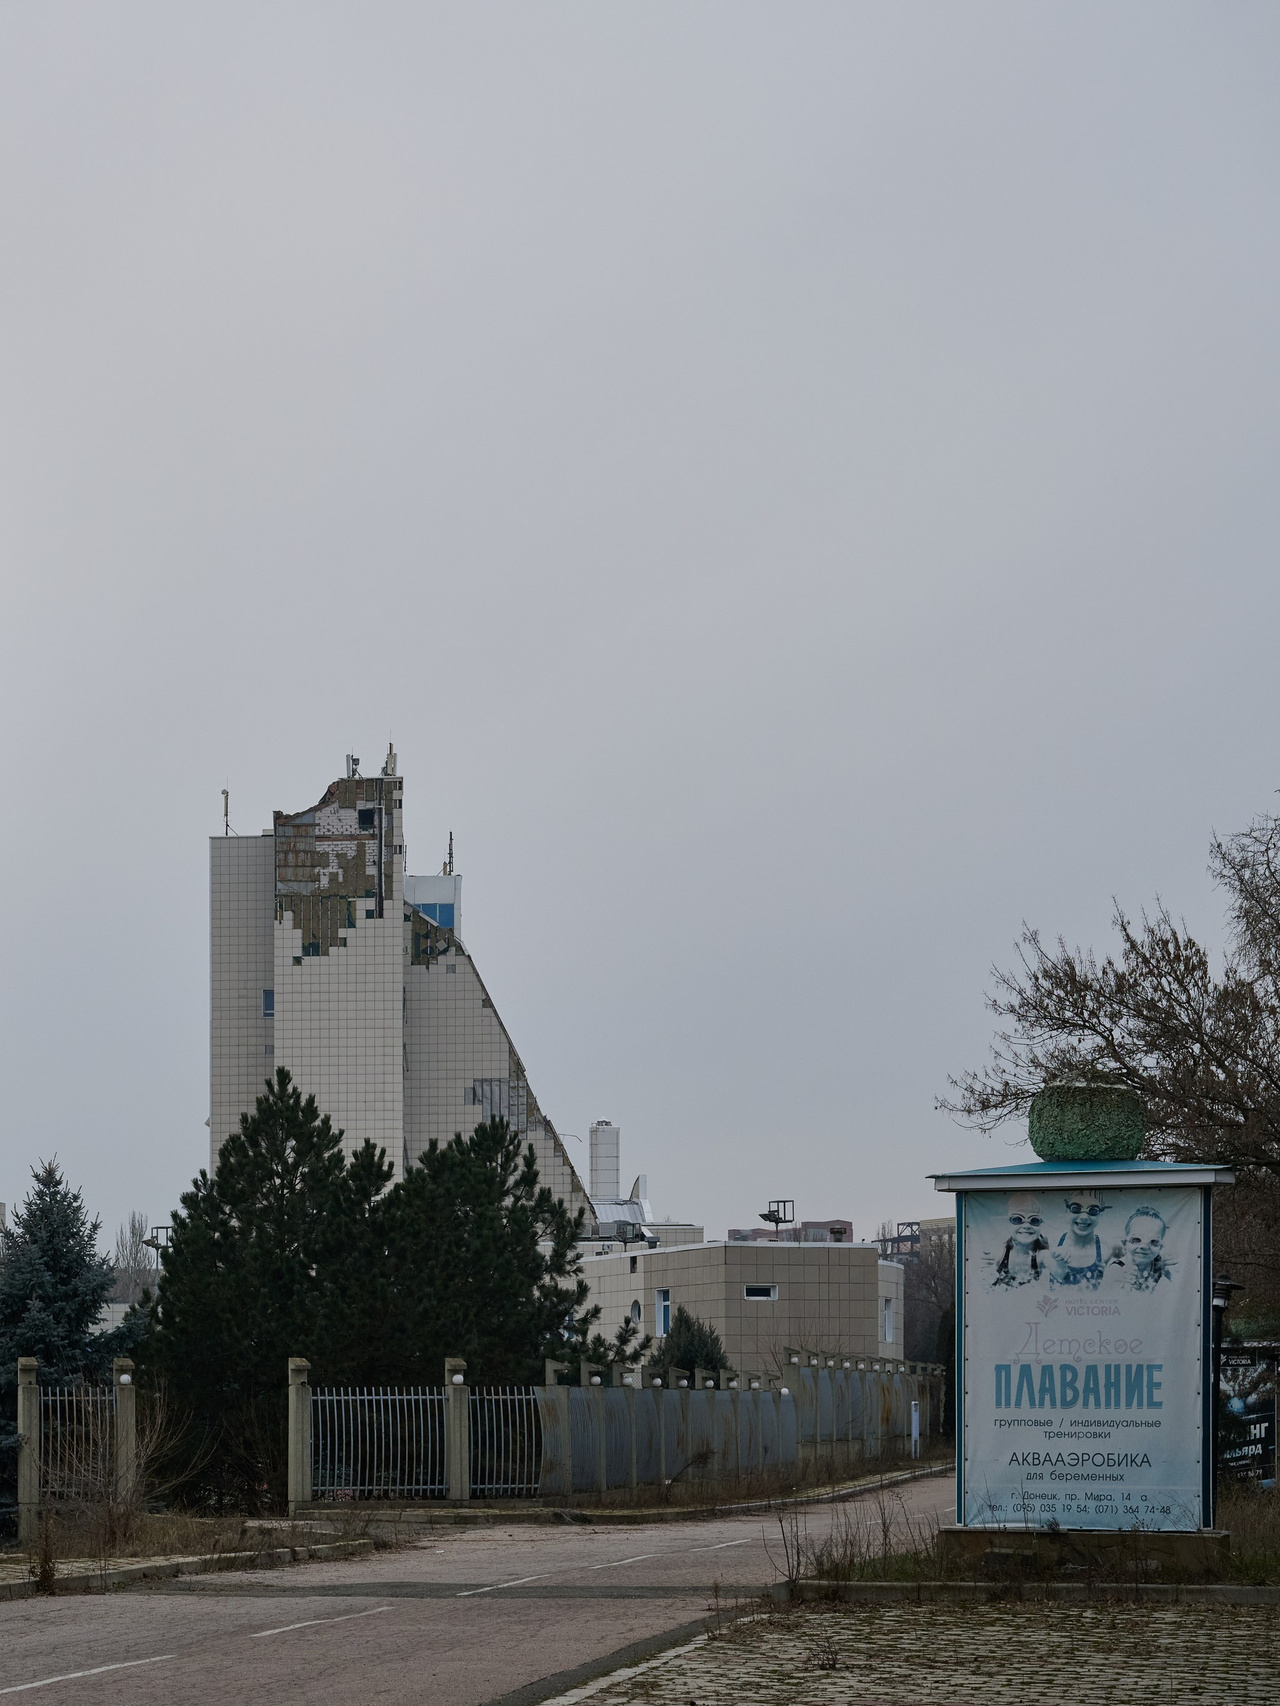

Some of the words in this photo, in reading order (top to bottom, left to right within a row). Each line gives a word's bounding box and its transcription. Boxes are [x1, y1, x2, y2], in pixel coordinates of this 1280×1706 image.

[1065, 1305, 1121, 1316] VICTORIA
[1013, 1321, 1144, 1365] Детское
[994, 1363, 1163, 1410] ПЛАВАНИЕ
[994, 1418, 1053, 1428] групповые
[1070, 1419, 1162, 1429] индивидуальные
[1043, 1431, 1111, 1440] тренировки
[1008, 1452, 1152, 1468] АКВААЭРОБИКА
[1025, 1472, 1044, 1481] для
[1050, 1470, 1125, 1482] беременных
[1011, 1492, 1018, 1500] г.
[1023, 1491, 1060, 1501] Донецк,
[1065, 1493, 1079, 1502] пр.
[1084, 1492, 1116, 1502] Мира,
[1121, 1492, 1131, 1501] 14
[1140, 1494, 1148, 1502] а
[1040, 1503, 1057, 1513] 035
[1062, 1504, 1072, 1513] 19
[1076, 1504, 1090, 1514] 54;
[1094, 1504, 1119, 1515] (071)
[1123, 1505, 1140, 1514] 364
